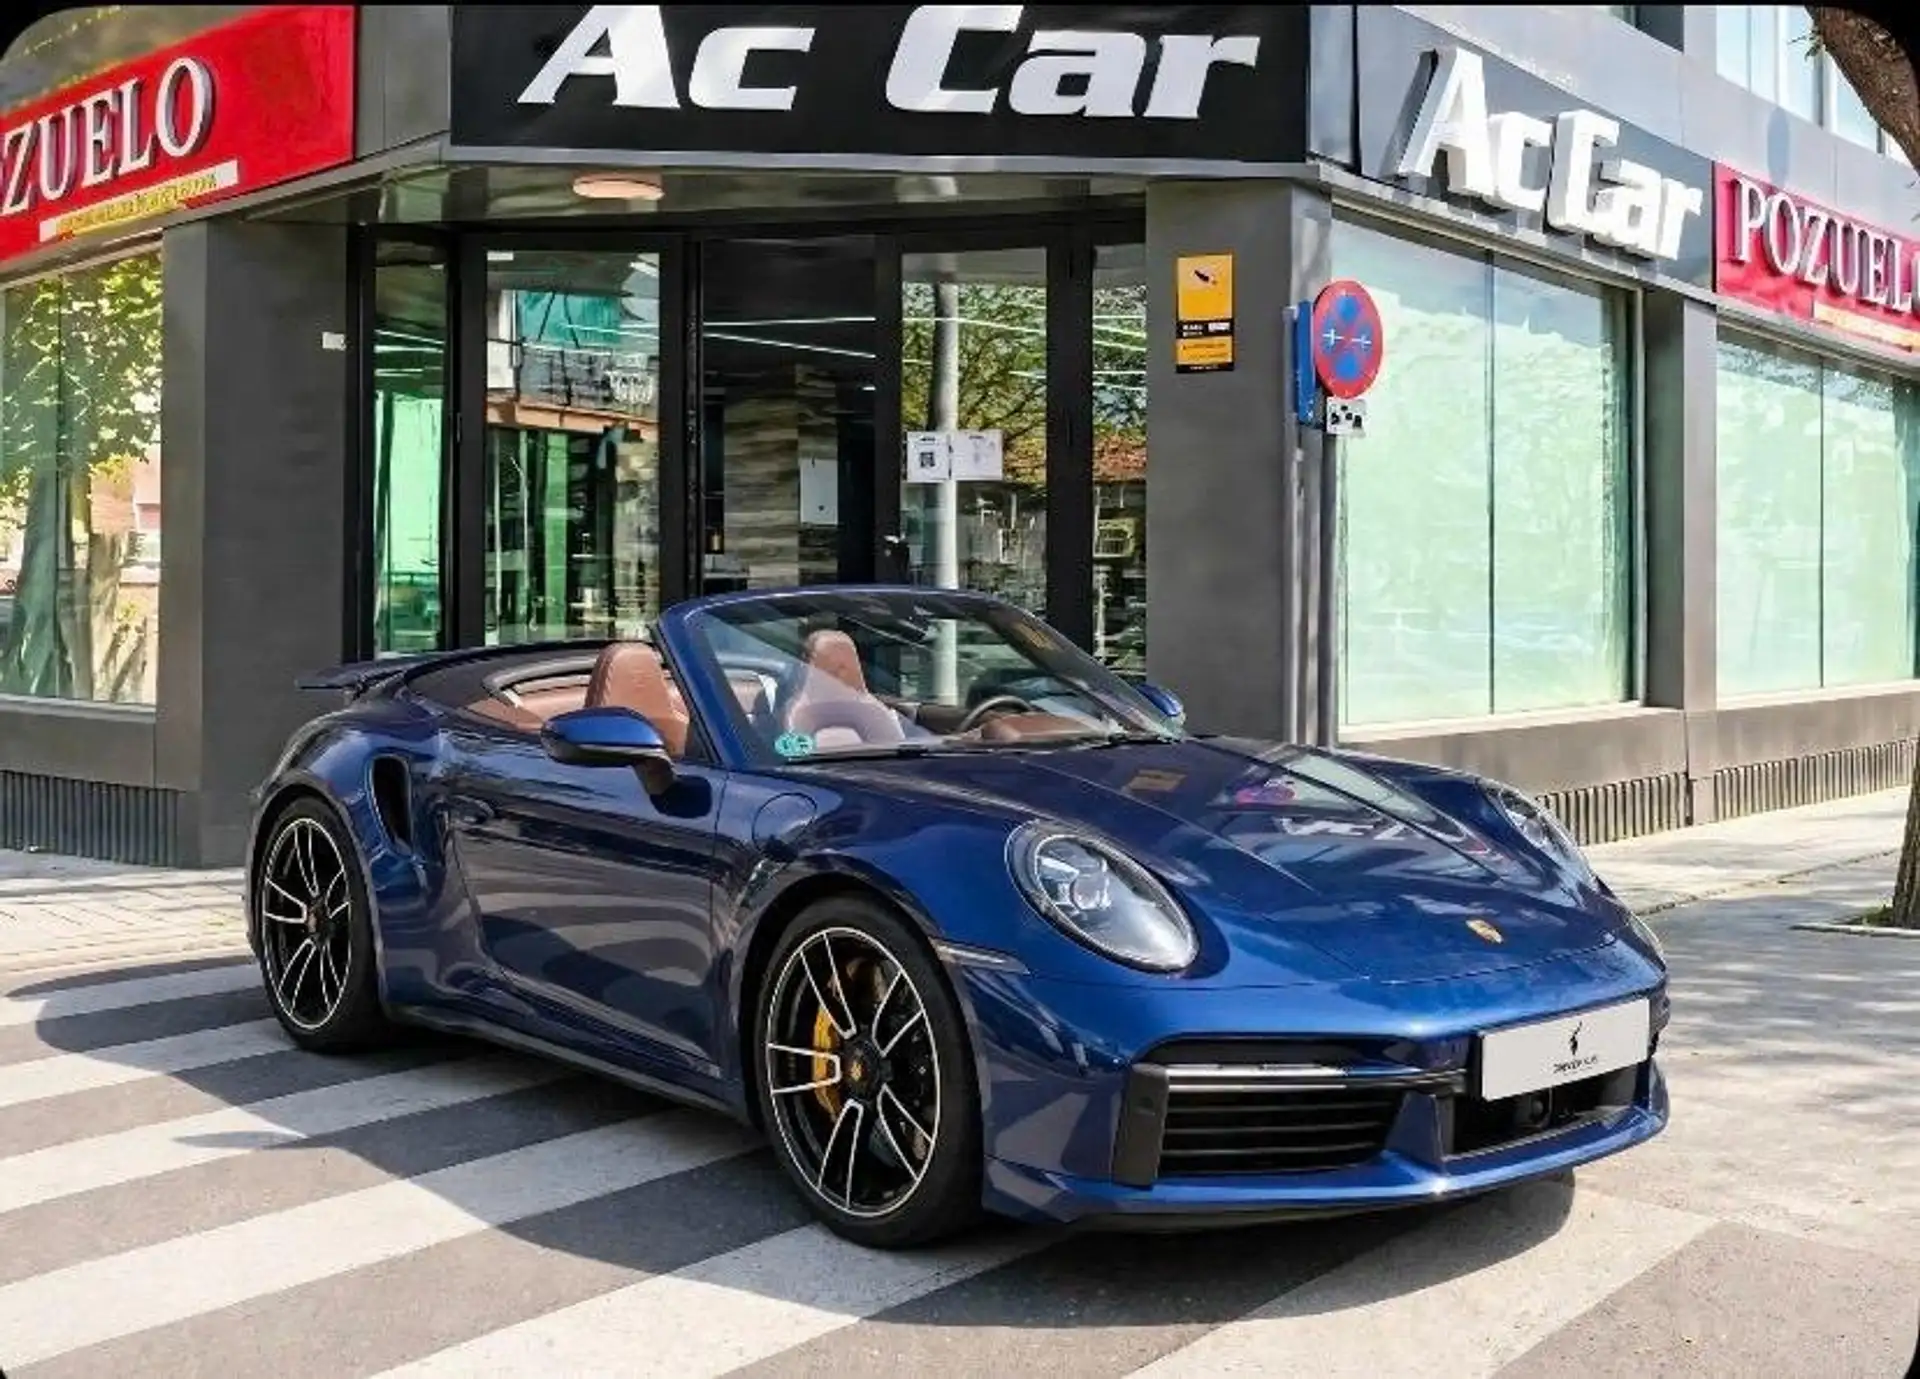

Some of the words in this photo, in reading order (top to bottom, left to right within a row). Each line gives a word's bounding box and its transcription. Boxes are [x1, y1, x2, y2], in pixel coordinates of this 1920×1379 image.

[517, 5, 816, 111] Ac
[885, 5, 1261, 118] Car
[1734, 177, 1920, 315] POZUEL
